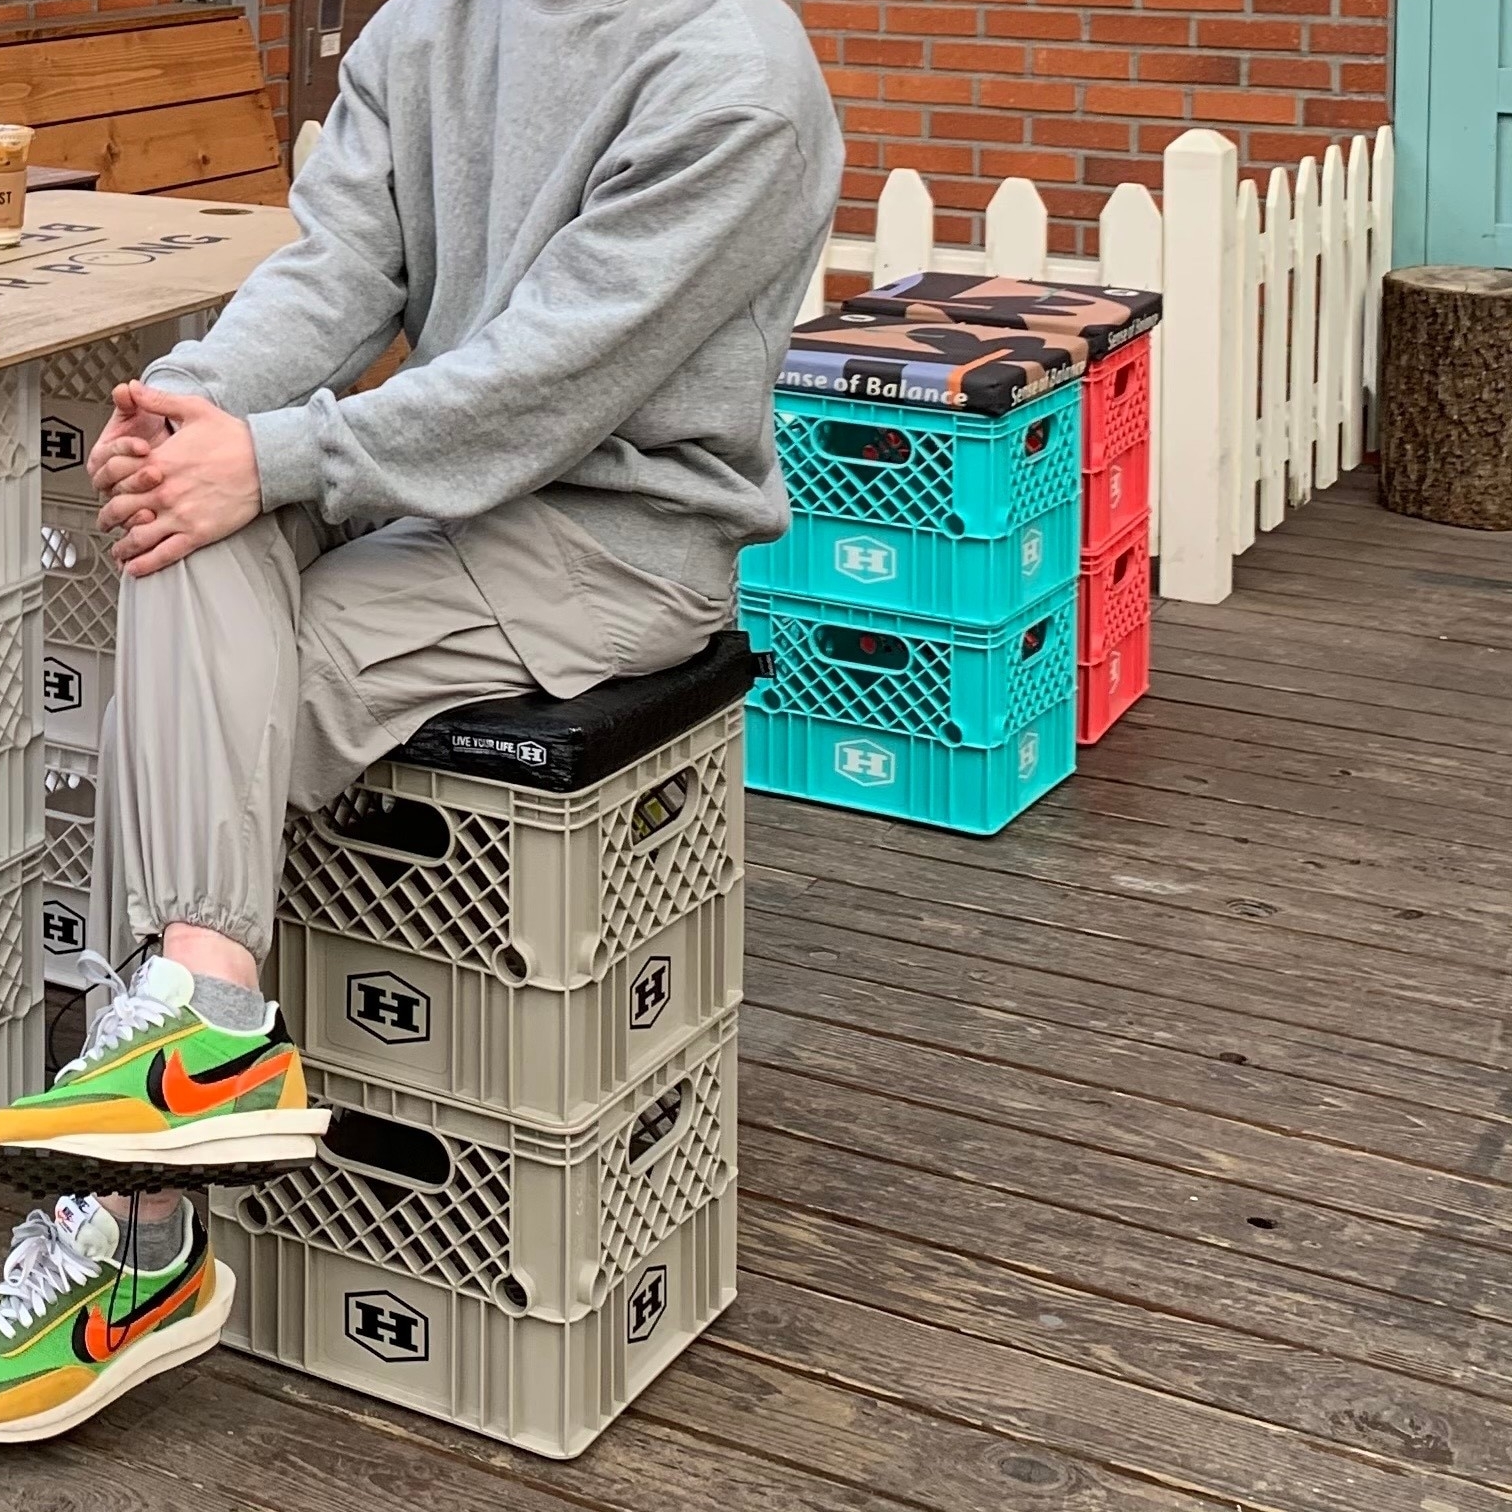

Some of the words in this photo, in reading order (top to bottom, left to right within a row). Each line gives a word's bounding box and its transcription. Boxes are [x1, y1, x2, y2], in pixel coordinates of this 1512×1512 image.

[777, 370, 829, 388] ense
[833, 373, 862, 394] of
[866, 376, 969, 408] Balance
[40, 429, 76, 460] H
[843, 544, 889, 575] H
[452, 735, 471, 748] LIVE
[473, 736, 495, 749] YOUR
[520, 746, 543, 763] H
[843, 747, 889, 779] H
[43, 912, 79, 946] H
[356, 982, 420, 1034] H
[634, 965, 667, 1021] H
[632, 1274, 663, 1334] H
[355, 1300, 419, 1353] H
